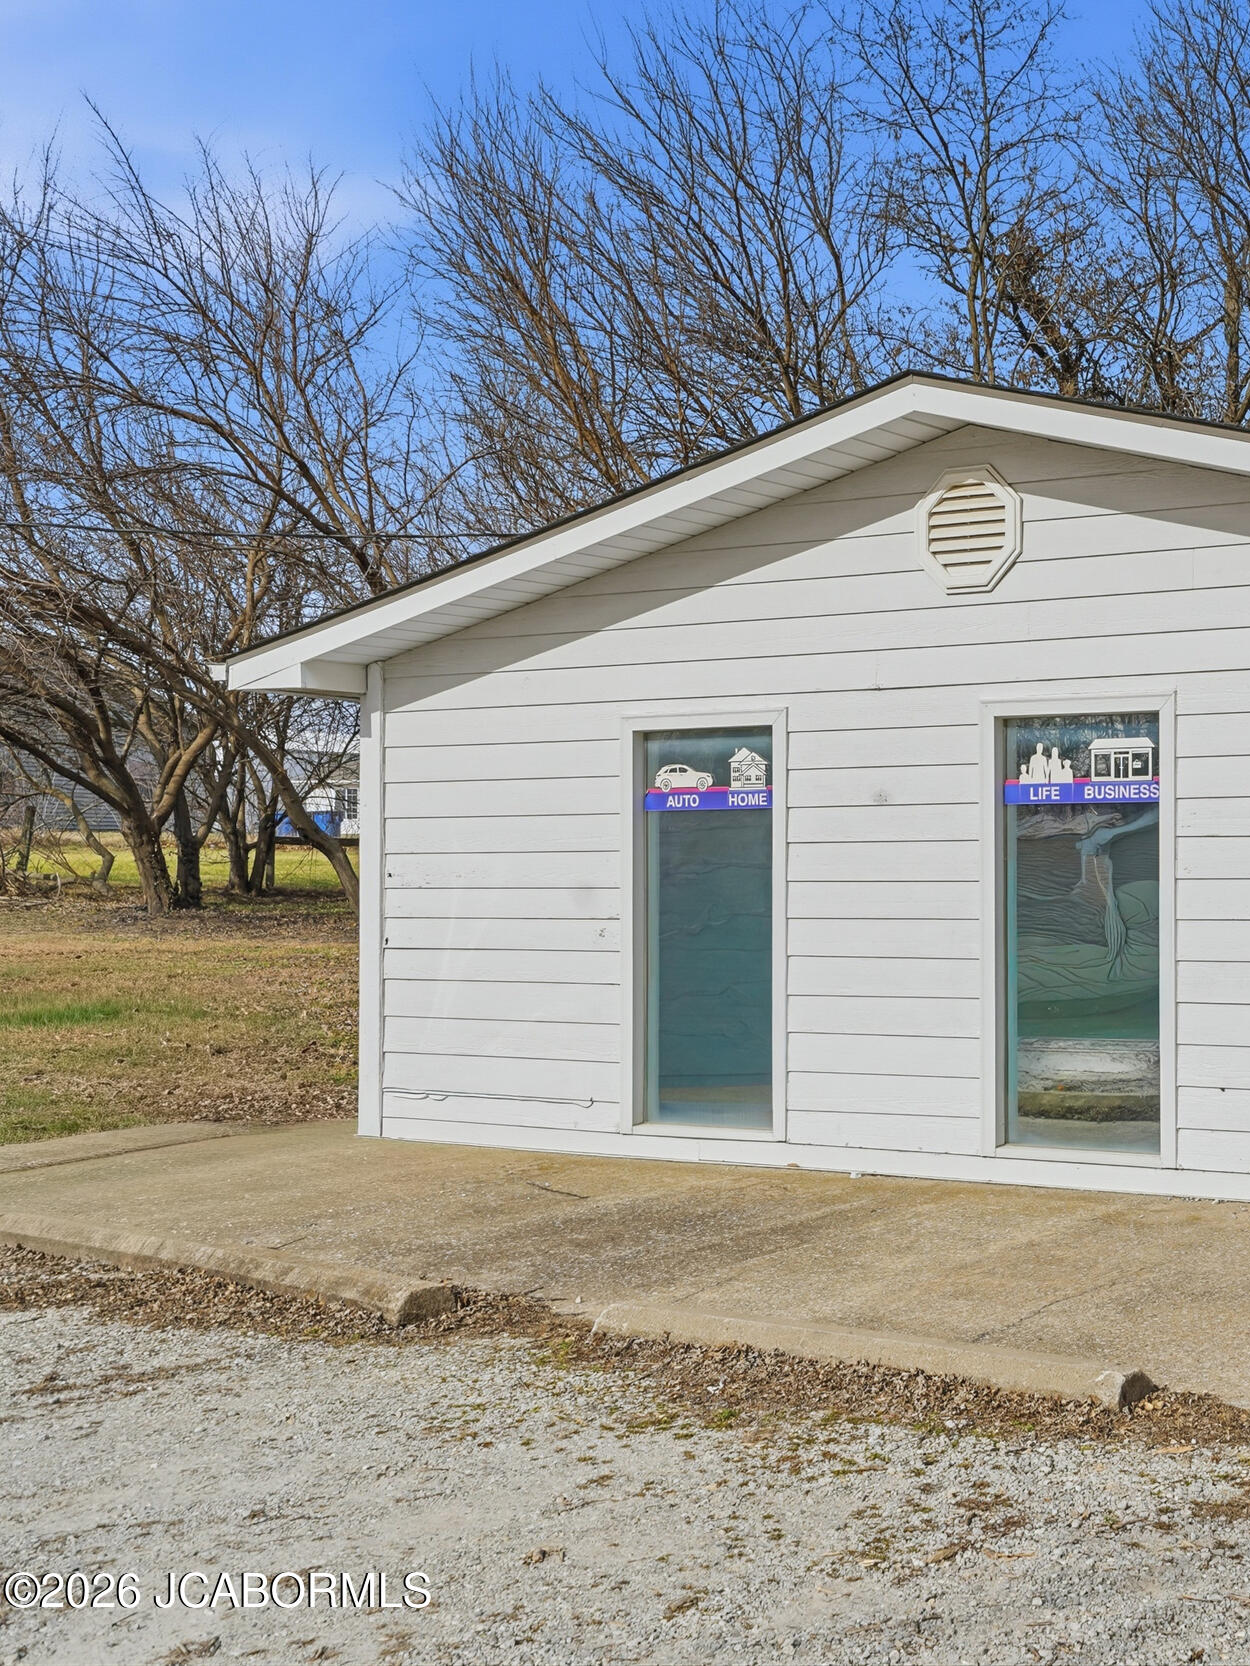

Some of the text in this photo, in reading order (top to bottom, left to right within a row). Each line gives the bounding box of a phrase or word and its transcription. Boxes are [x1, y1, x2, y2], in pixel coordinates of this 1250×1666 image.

[1029, 784, 1159, 800] LIFE BUSINESS
[666, 793, 768, 808] AUTO HOME
